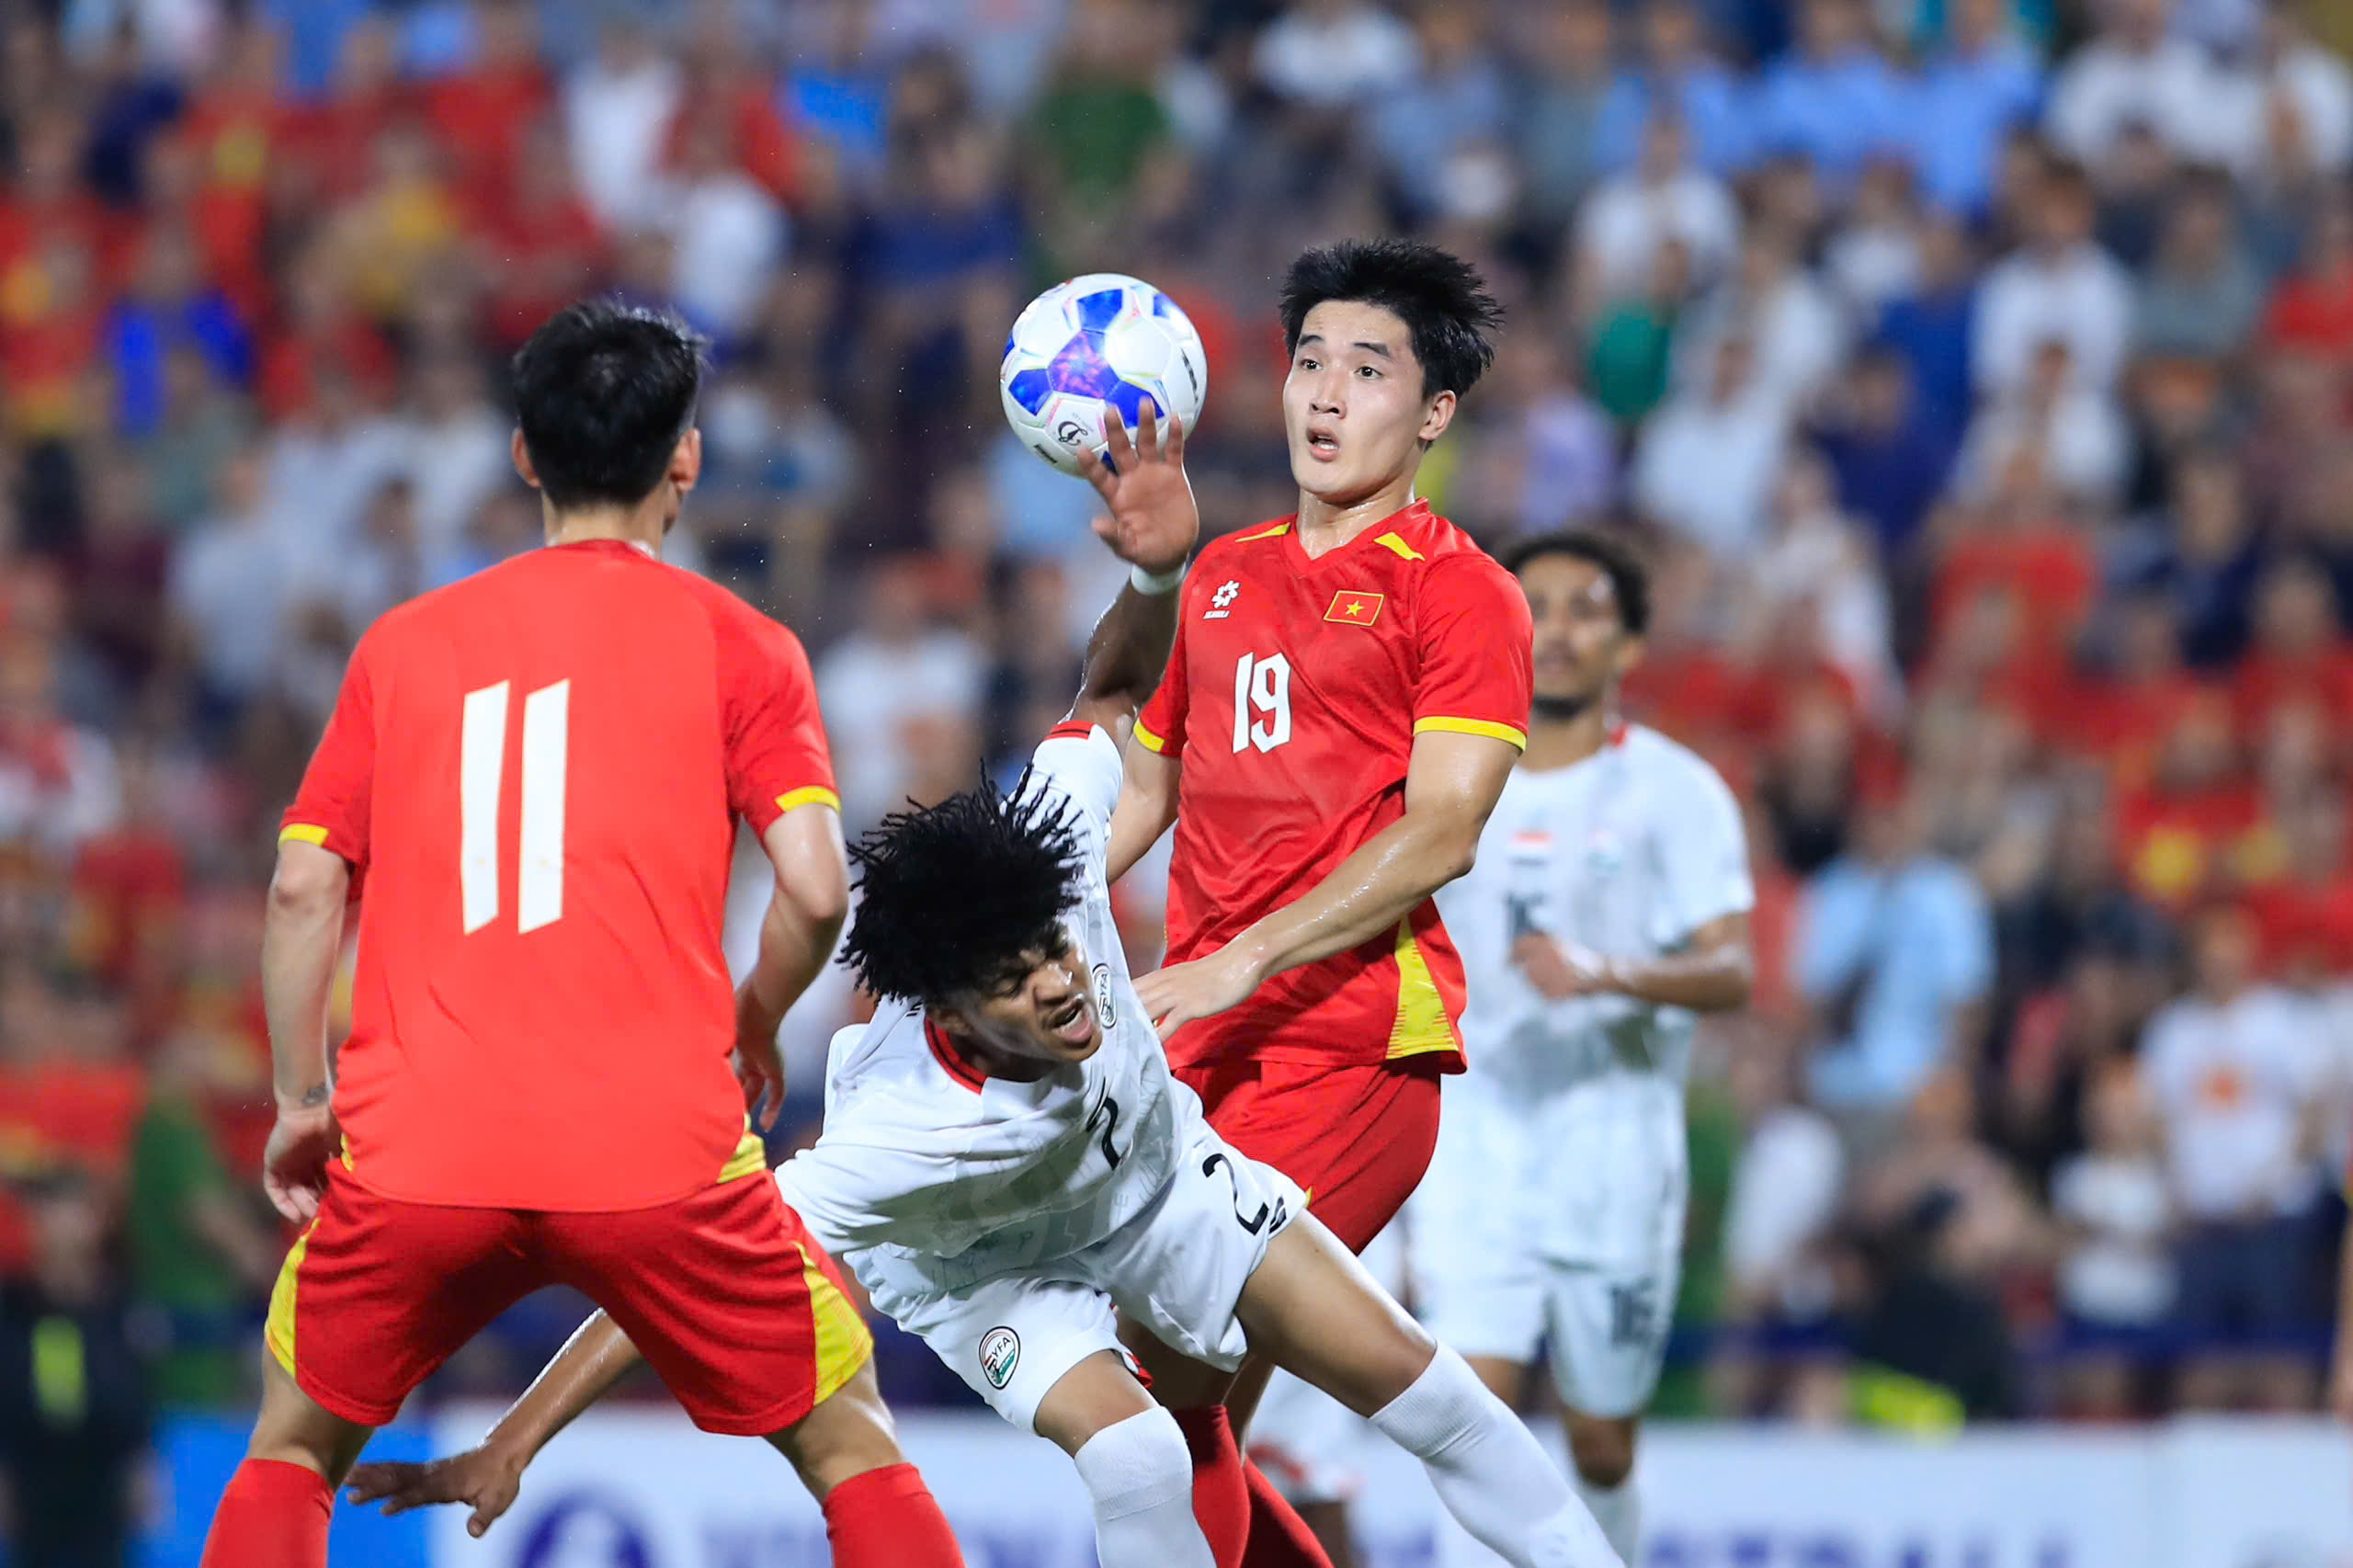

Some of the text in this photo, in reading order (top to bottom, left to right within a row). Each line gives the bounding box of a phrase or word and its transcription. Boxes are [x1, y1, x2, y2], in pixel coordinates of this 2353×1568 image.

[1233, 652, 1291, 754] 19
[460, 678, 570, 936] 11
[992, 1336, 1011, 1358] YFA
